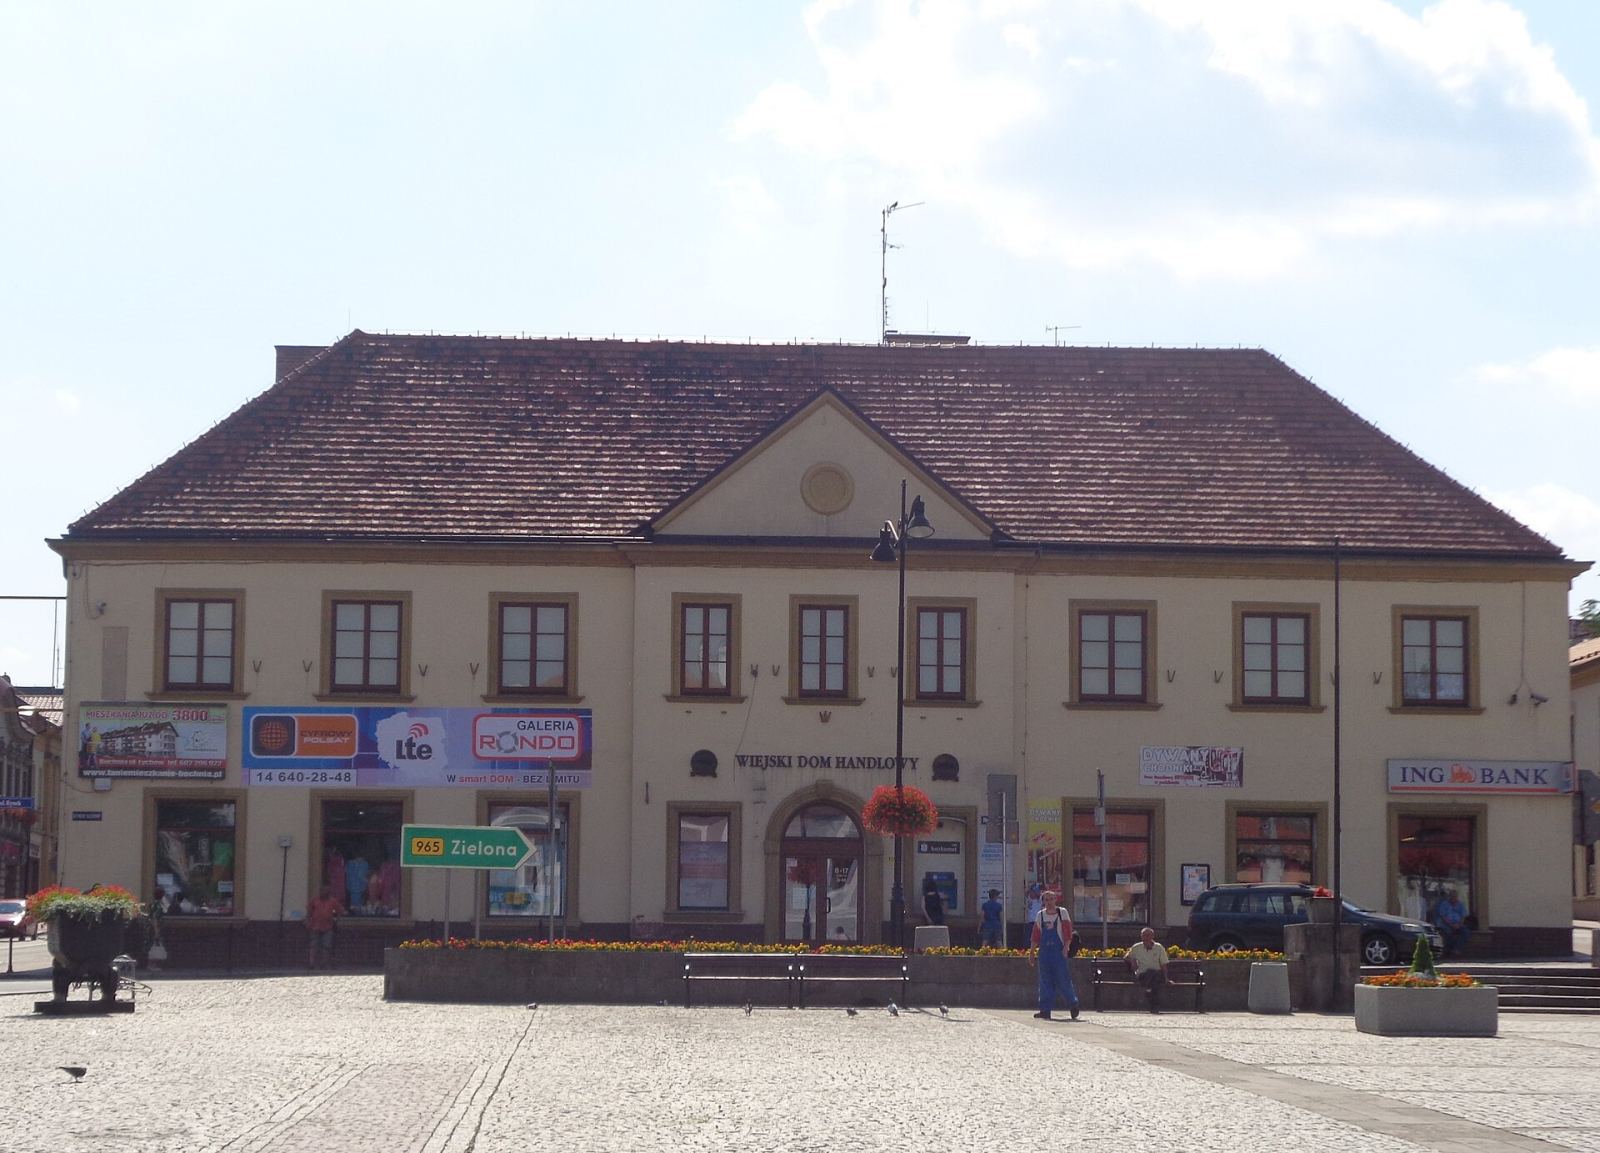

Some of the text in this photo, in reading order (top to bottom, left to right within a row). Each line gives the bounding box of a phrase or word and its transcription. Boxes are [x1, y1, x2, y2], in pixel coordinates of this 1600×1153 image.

[172, 708, 208, 721] 3800
[517, 720, 575, 731] GALERIA
[479, 732, 575, 753] RONDO
[1143, 748, 1209, 761] DYWANY
[735, 755, 793, 770] WIEJSKI
[797, 755, 832, 769] DOM
[256, 772, 352, 782] 14 640-28-48
[446, 775, 456, 783] W
[459, 775, 487, 783] smart
[489, 775, 514, 783] DOM
[523, 775, 543, 783] BEZ
[545, 775, 580, 783] LMITU
[1401, 767, 1549, 784] ING BANK
[416, 840, 517, 856] 965 Zielona
